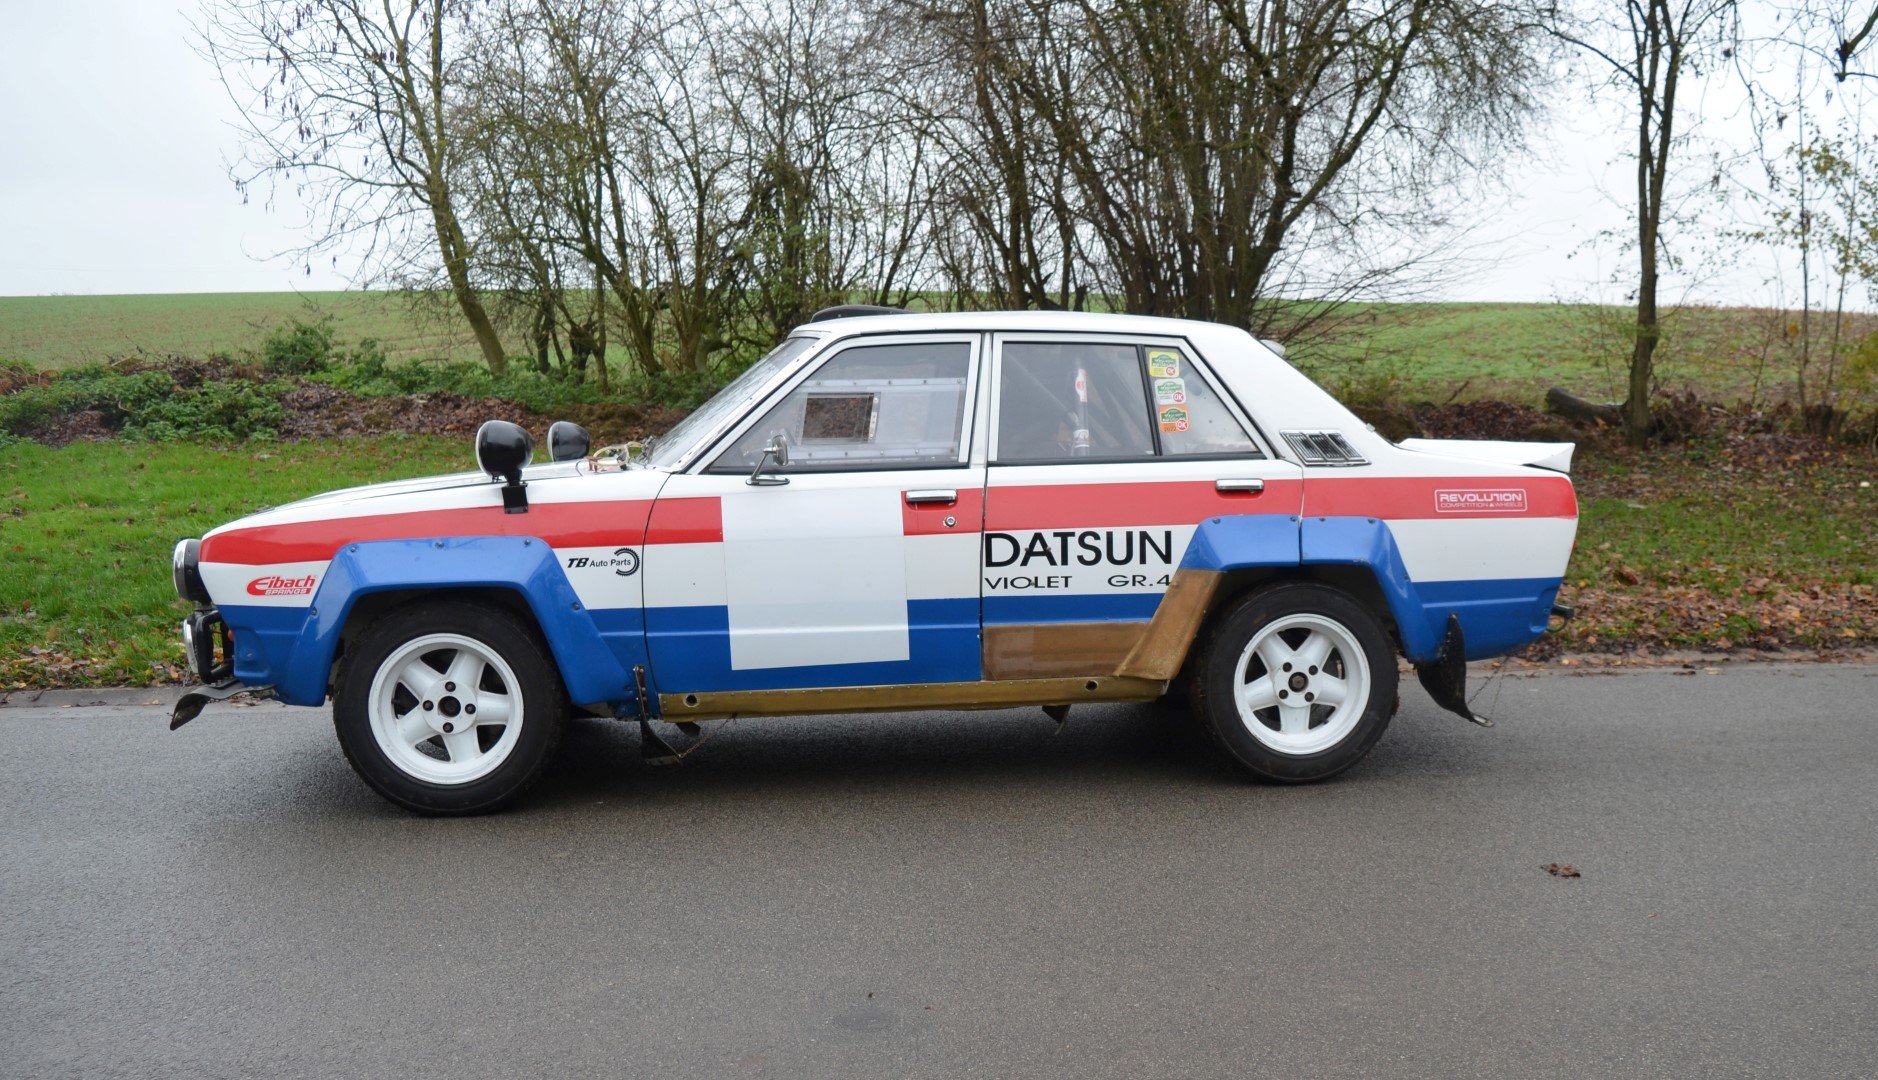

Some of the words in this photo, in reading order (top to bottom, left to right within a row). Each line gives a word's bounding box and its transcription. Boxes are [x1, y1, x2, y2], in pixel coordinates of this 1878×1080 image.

[1174, 393, 1183, 401] OK
[1177, 421, 1187, 429] OK
[1439, 493, 1522, 502] REVOLUTION
[985, 530, 1172, 567] DATSUN
[567, 557, 590, 568] TB
[610, 559, 632, 567] Parts
[246, 574, 316, 596] Eibach
[985, 575, 1073, 590] VIOLET
[1107, 574, 1172, 587] GR.4
[264, 588, 308, 596] SPRINGS
